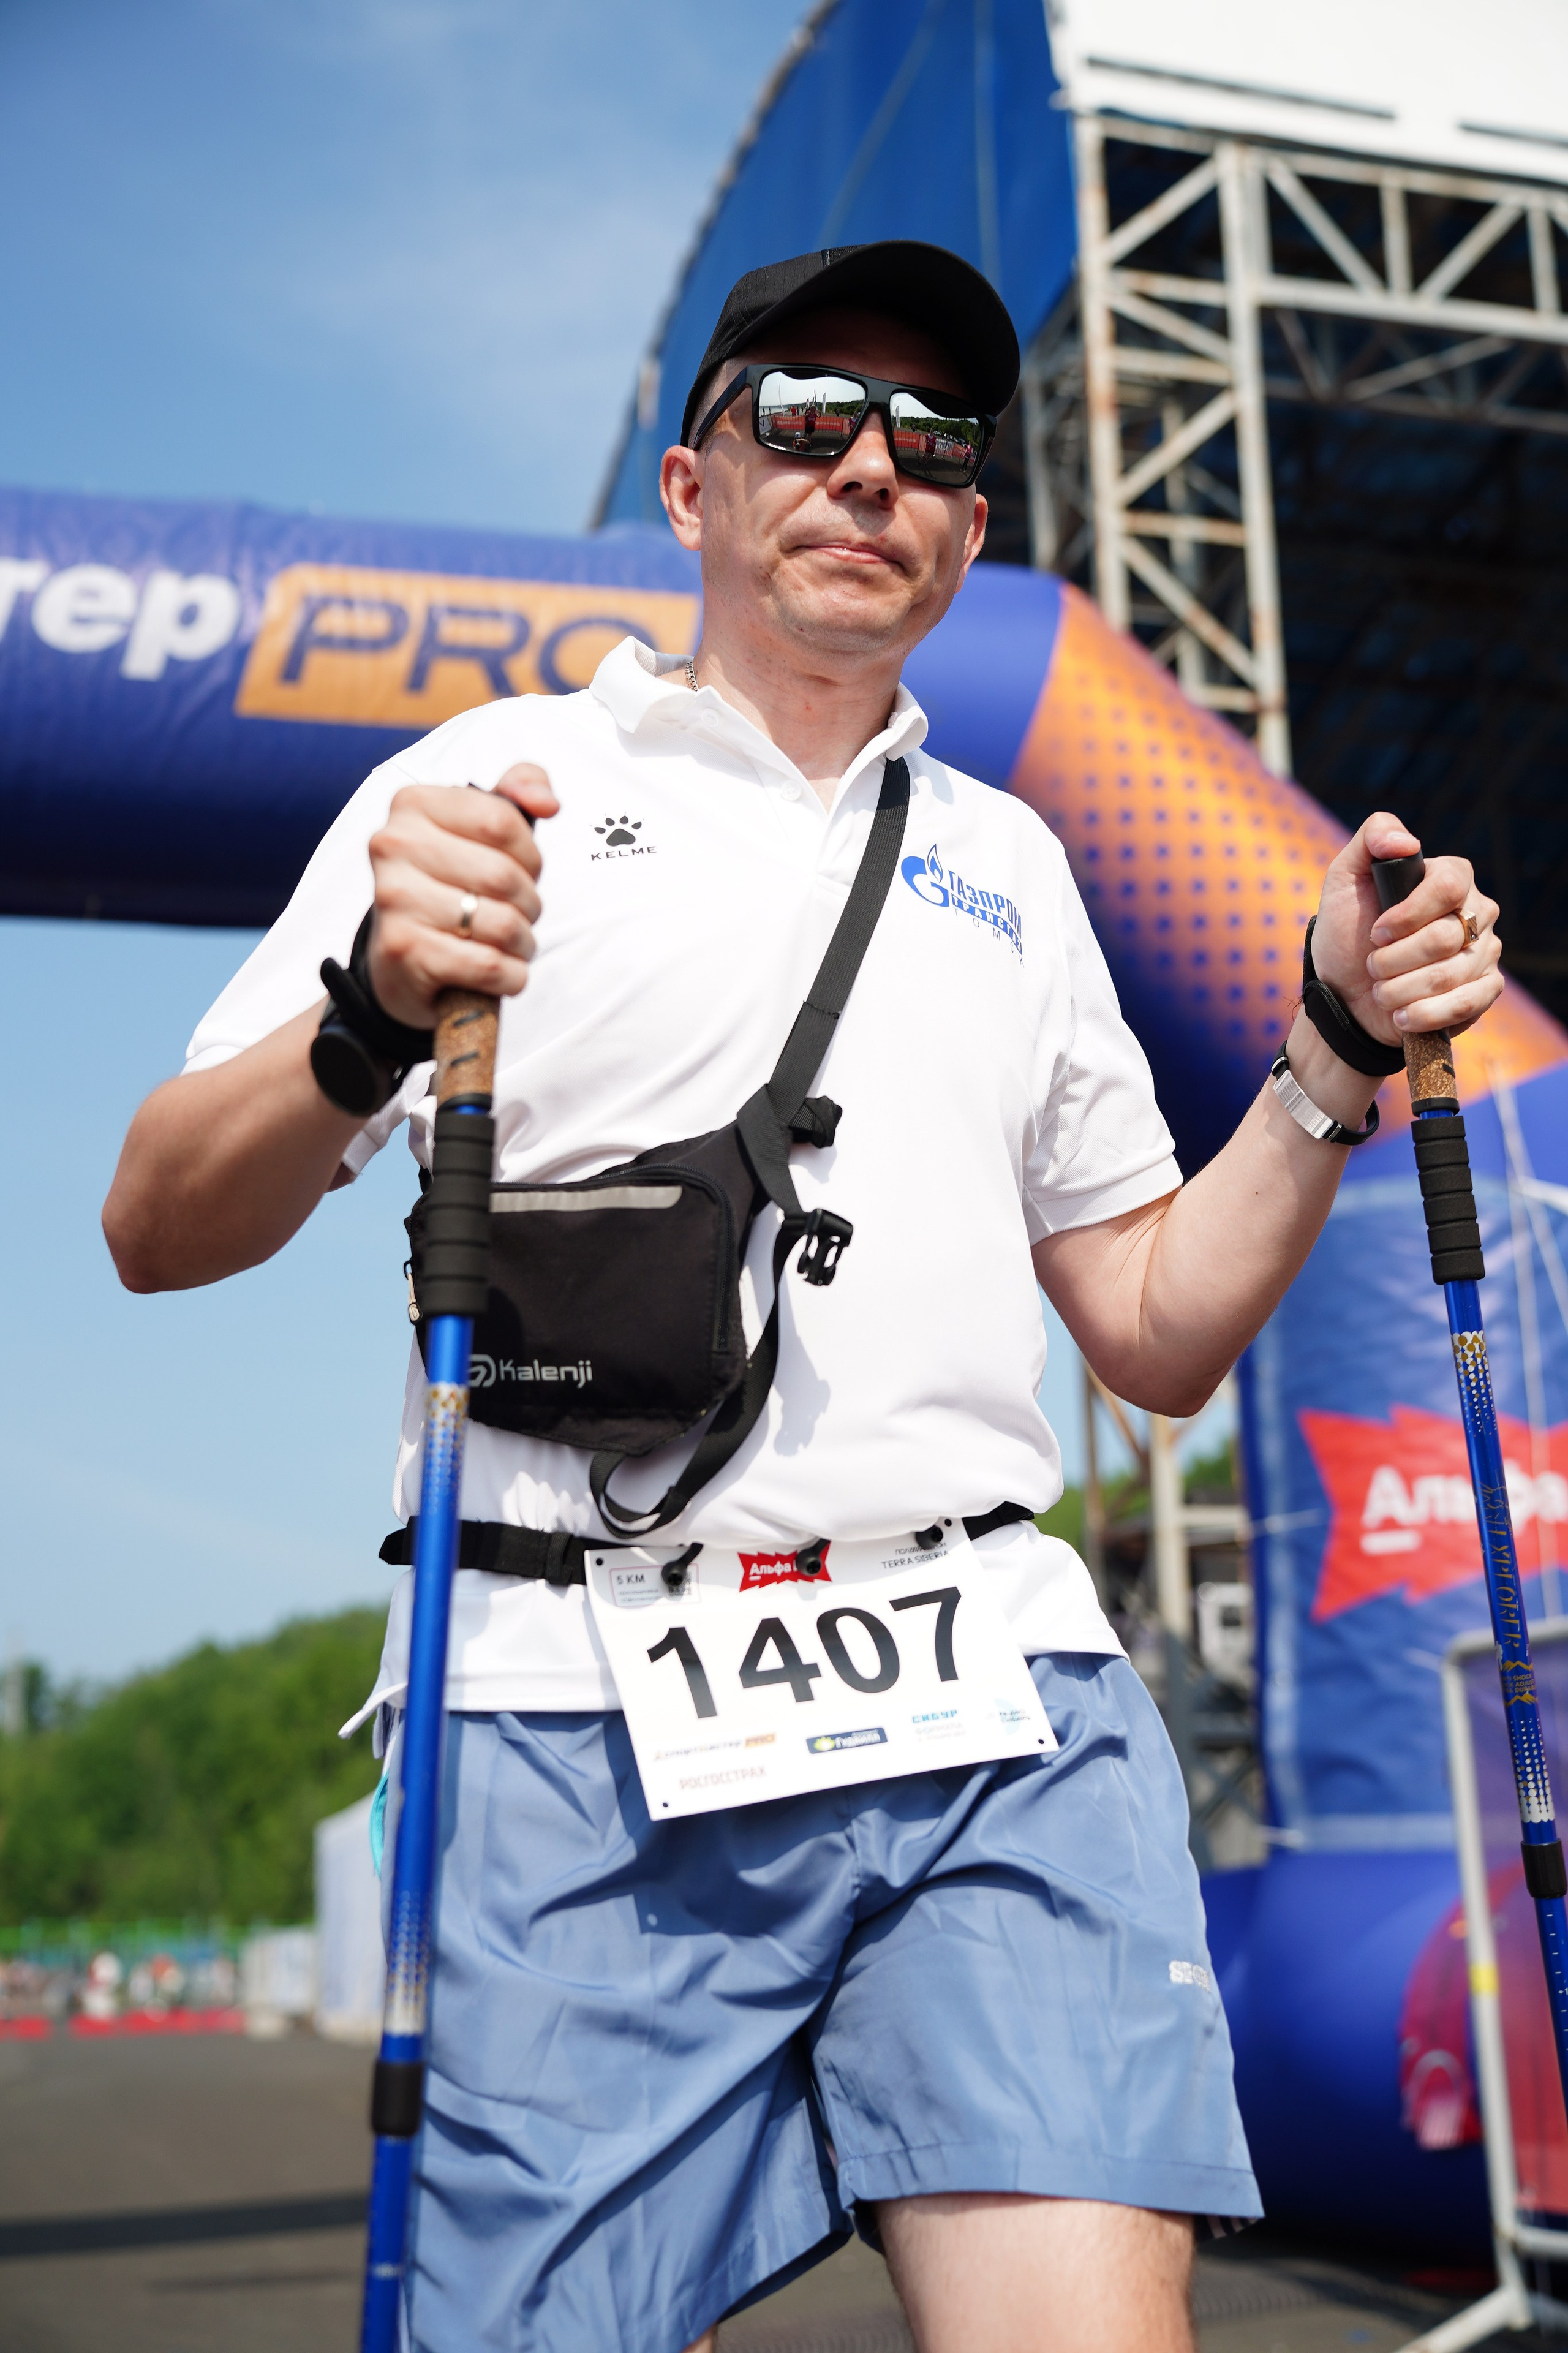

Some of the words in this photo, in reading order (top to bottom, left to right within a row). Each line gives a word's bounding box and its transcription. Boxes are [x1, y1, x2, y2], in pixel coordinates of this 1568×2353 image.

[278, 593, 660, 697] PRO
[590, 846, 657, 861] KELME
[948, 869, 1022, 939] ГАЗПРОМ
[952, 894, 1022, 954] ТРАНСГАЗ
[952, 907, 1025, 968] ТОМСК
[499, 1359, 593, 1389] Kalenji
[749, 1560, 791, 1576] Альфа
[881, 1558, 913, 1569] TERRA
[914, 1550, 949, 1563] SIBERIA
[616, 1575, 624, 1585] 5
[646, 1585, 962, 1719] 1407
[911, 1709, 958, 1723] СИБУР
